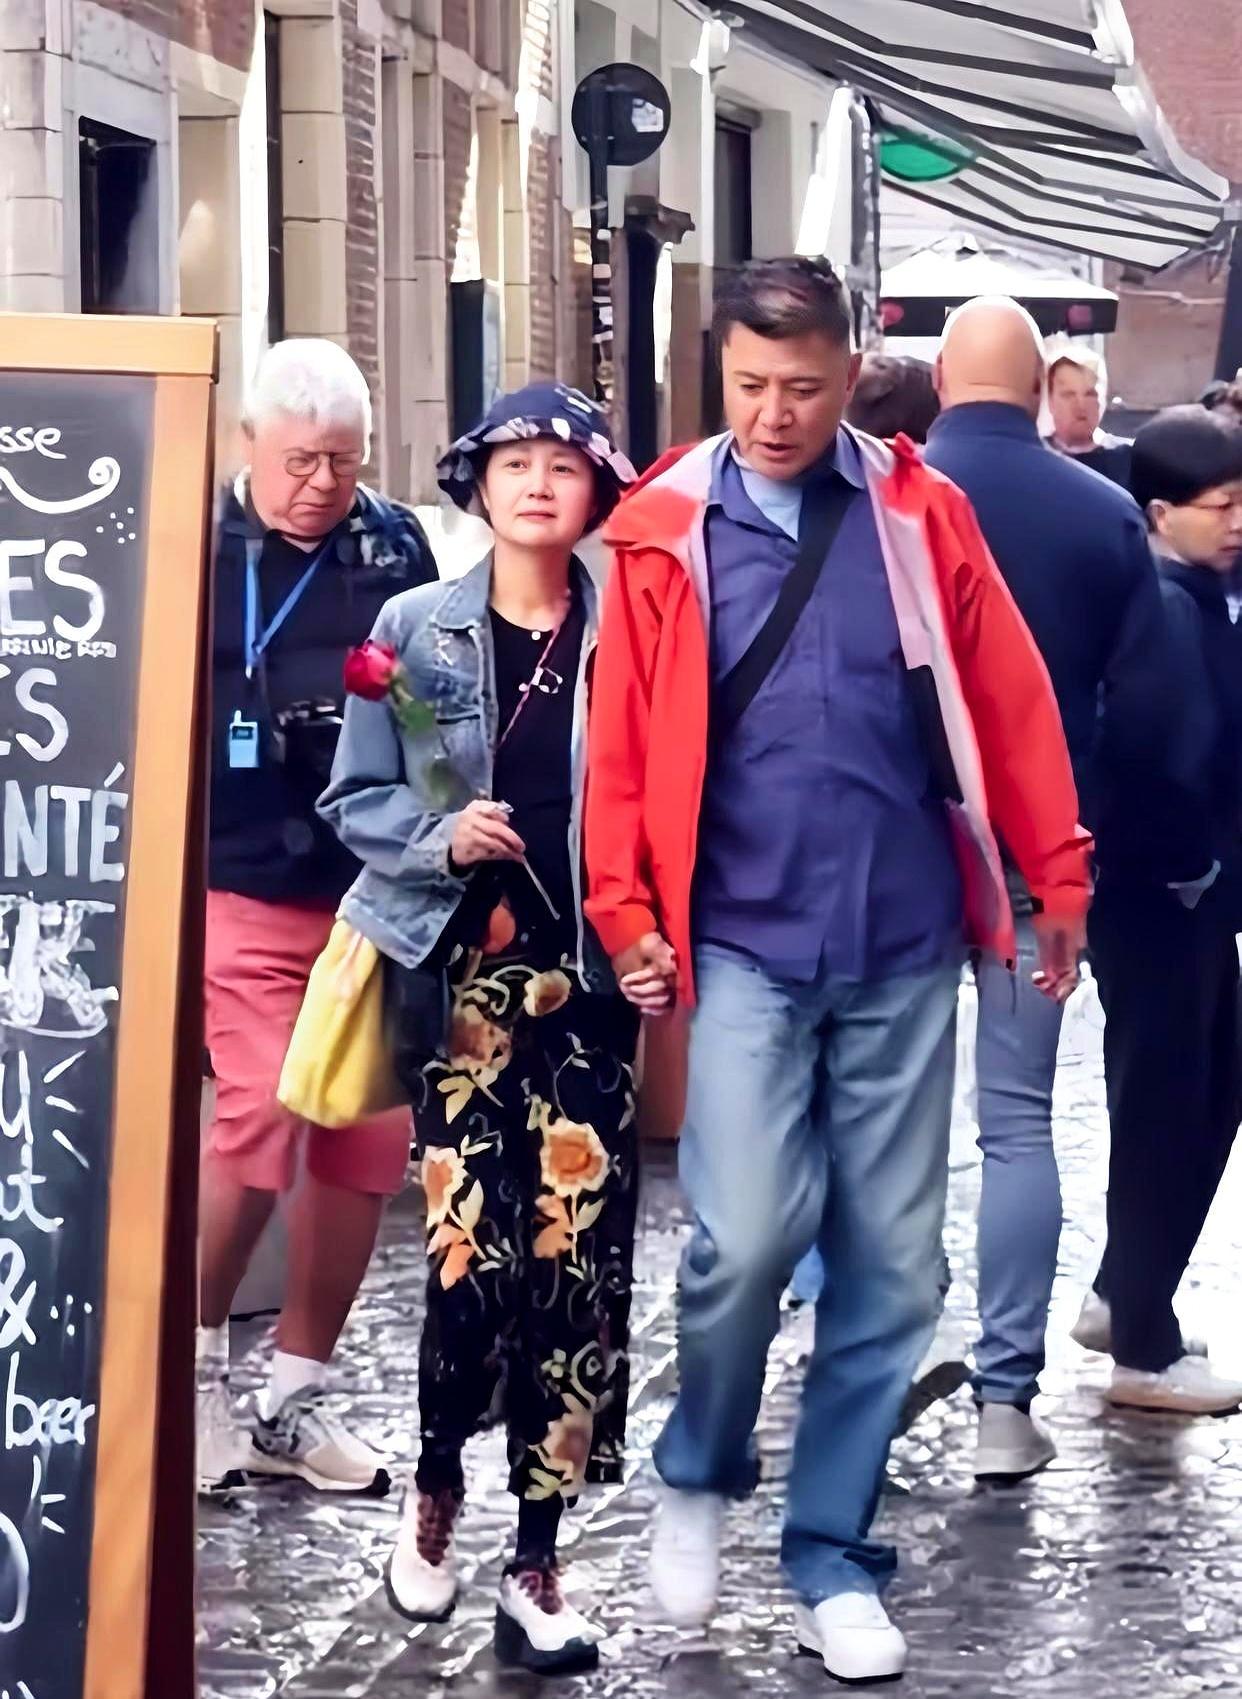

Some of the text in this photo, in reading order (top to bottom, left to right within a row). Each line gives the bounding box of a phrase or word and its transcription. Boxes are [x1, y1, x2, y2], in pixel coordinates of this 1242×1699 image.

[0, 538, 105, 642] ES
[0, 663, 69, 762] S
[4, 761, 128, 882] NTÉ
[5, 1351, 96, 1449] beer
